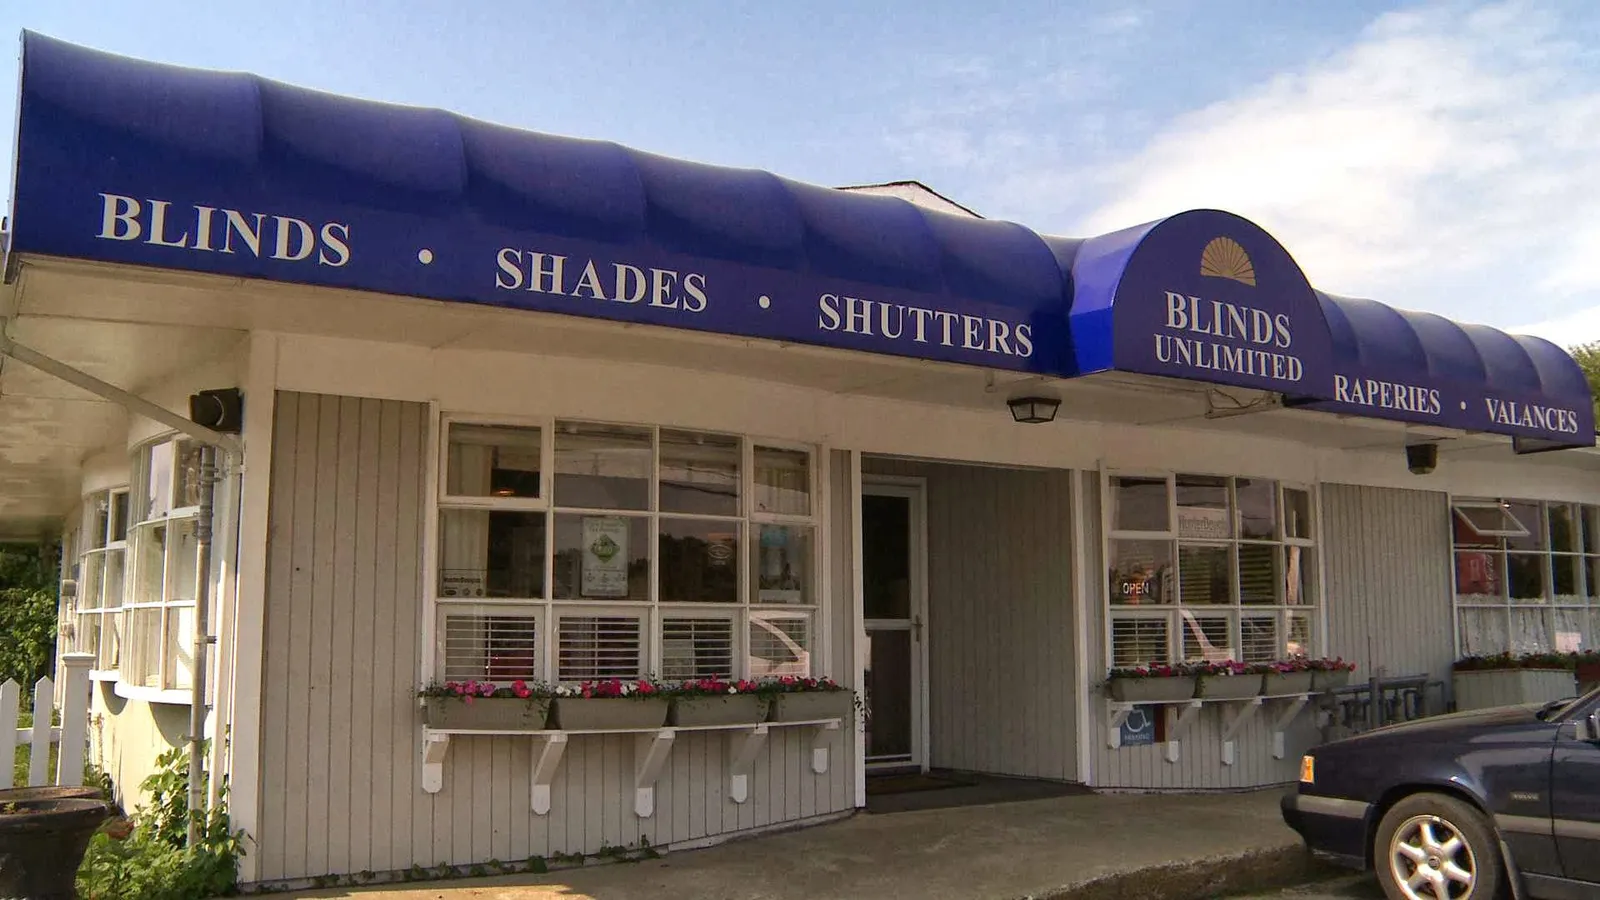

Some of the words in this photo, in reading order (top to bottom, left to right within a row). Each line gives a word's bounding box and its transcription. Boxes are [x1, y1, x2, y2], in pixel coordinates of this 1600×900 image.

[95, 192, 350, 267] BLINDS
[495, 248, 707, 312] SHADES
[818, 293, 1033, 358] SHUTTERS
[1164, 291, 1292, 348] BLINDS
[1153, 333, 1303, 382] UNLIMITED
[1333, 374, 1441, 415] RAPERIES
[1485, 398, 1578, 434] VALANCES
[1122, 581, 1149, 594] OPEN
